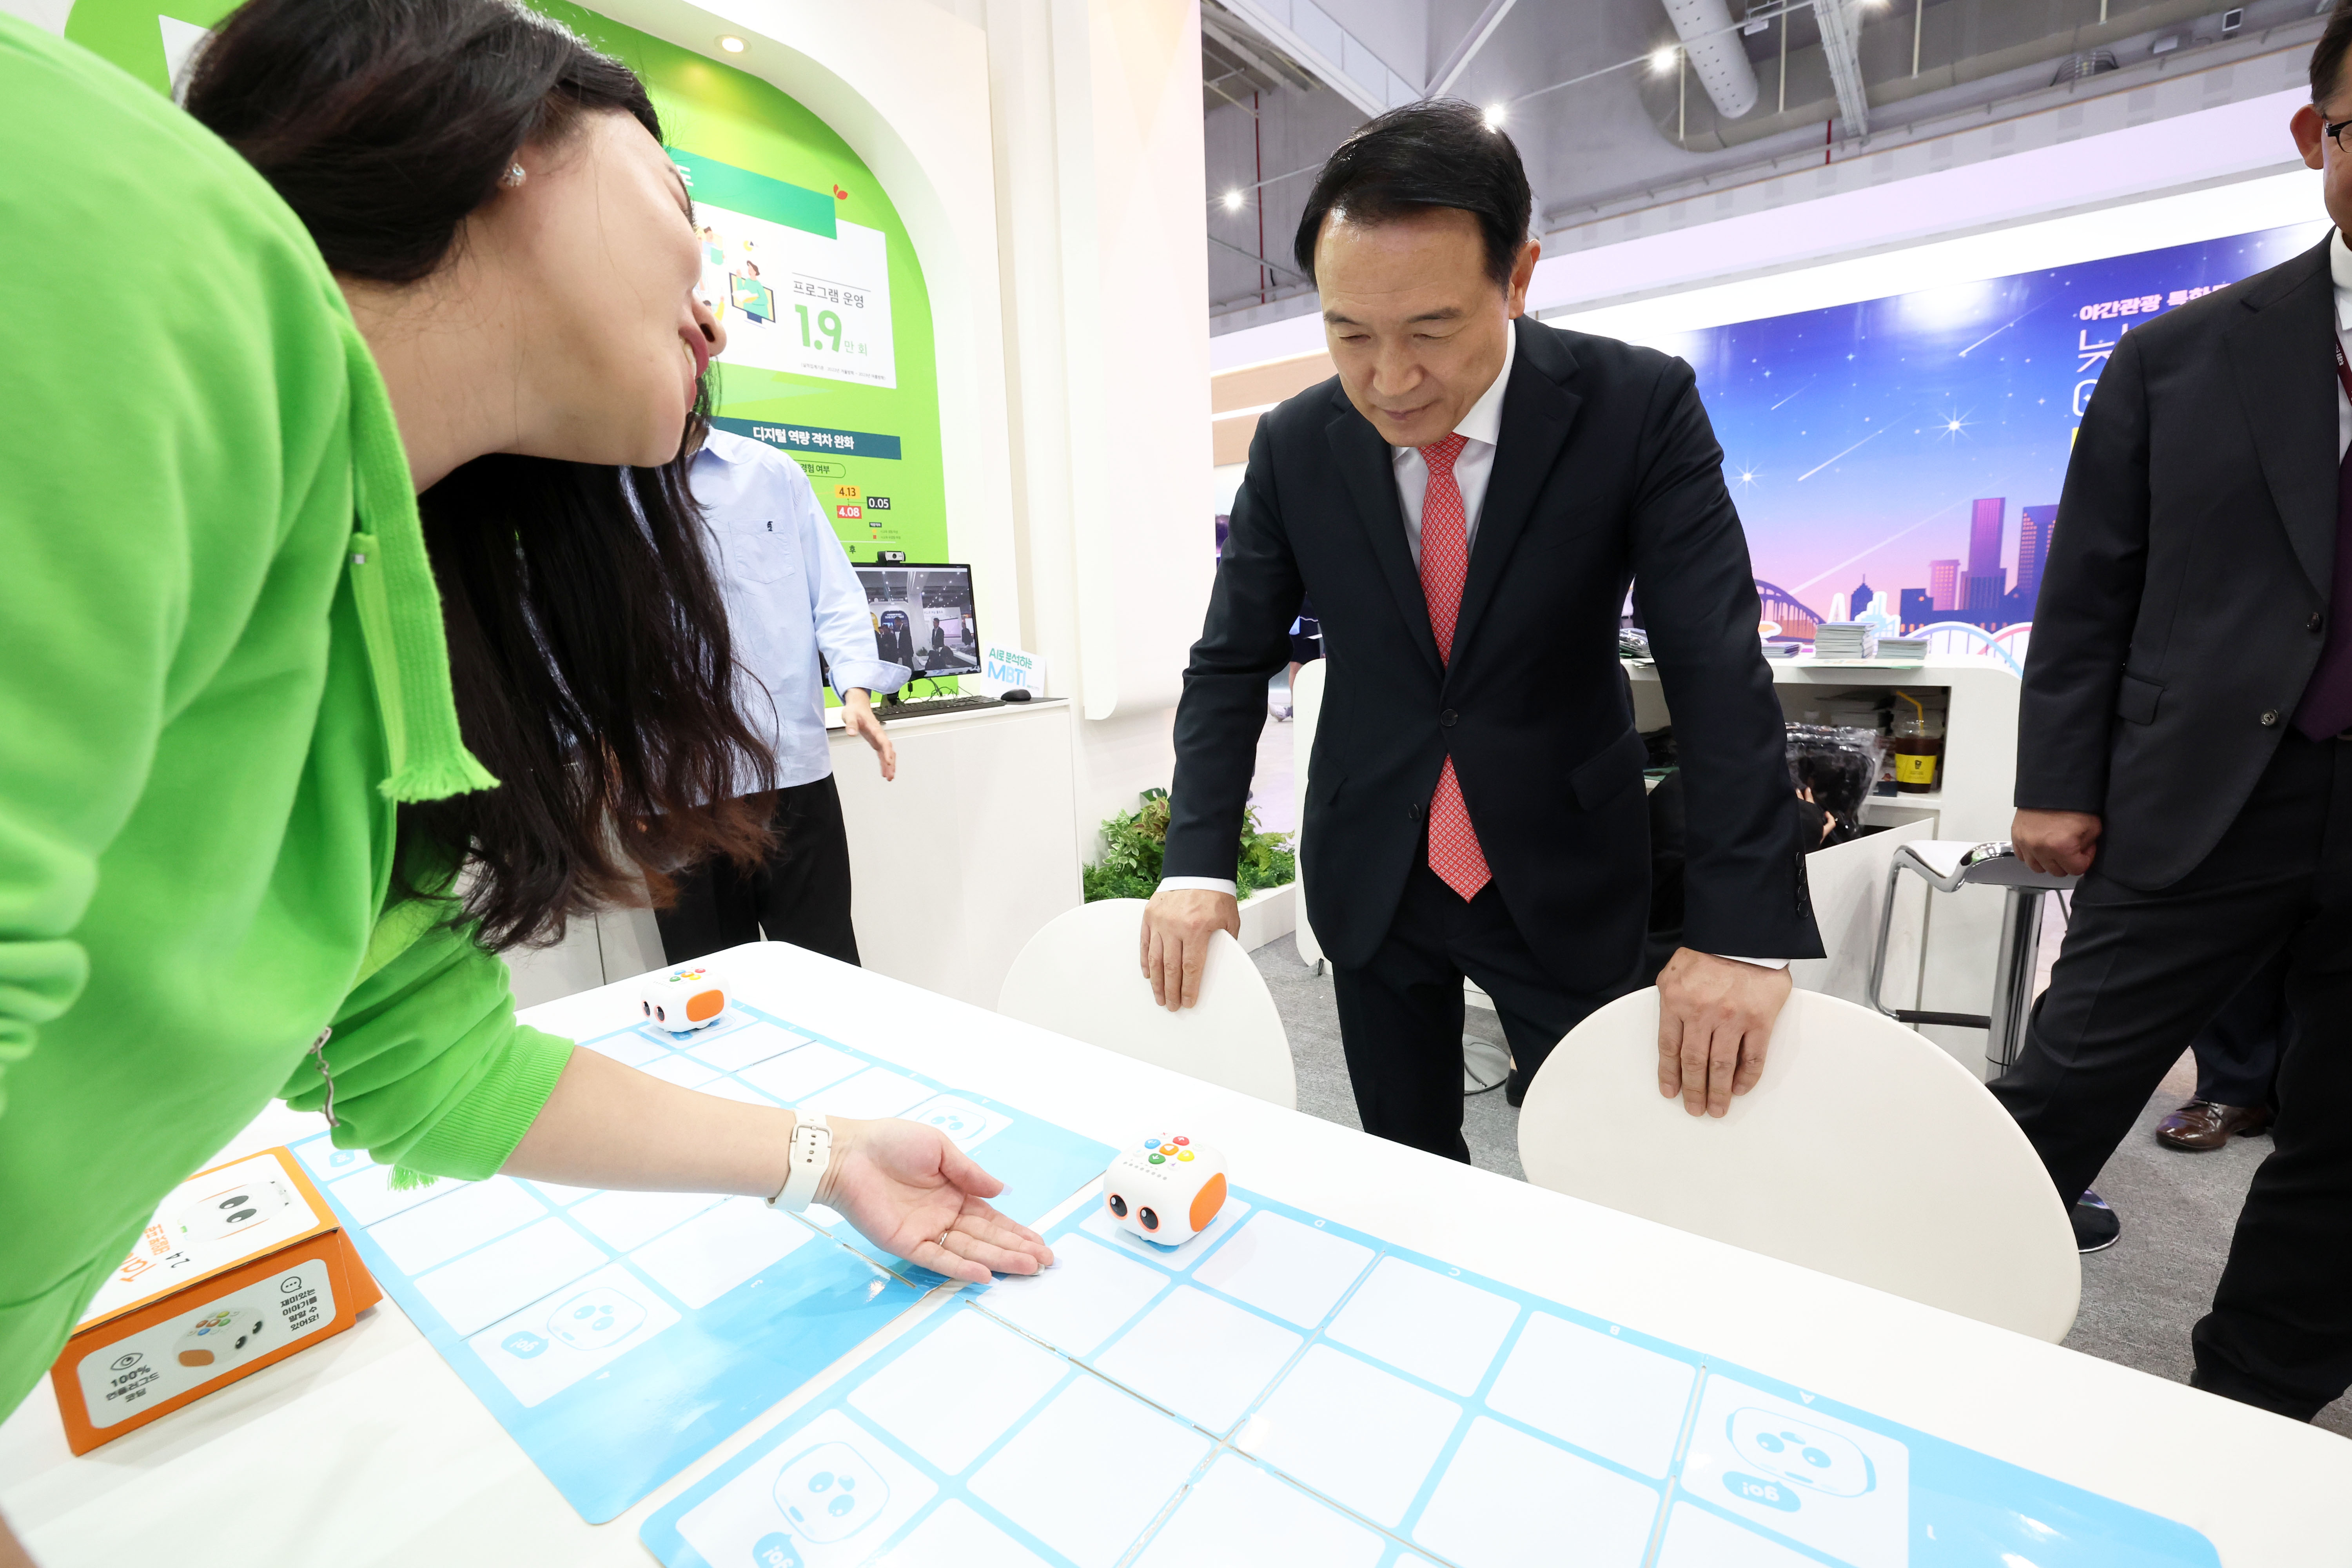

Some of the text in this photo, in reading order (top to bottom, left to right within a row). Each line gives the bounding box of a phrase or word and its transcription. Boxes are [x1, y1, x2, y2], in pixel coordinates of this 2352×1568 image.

[794, 281, 864, 309] 프로그램 운영
[2079, 294, 2162, 320] 야간관광
[795, 304, 842, 352] 1.9
[844, 340, 867, 356] 만 회
[753, 426, 855, 450] 디지털 역량 격차 완화
[800, 464, 830, 474] 경험 여부
[839, 487, 856, 497] 4.13
[839, 506, 860, 517] 4.08
[869, 498, 889, 509] 0.05
[849, 545, 856, 554] 후
[989, 648, 1033, 670] AI로 분석하는
[987, 661, 1026, 686] MBTI
[1314, 1219, 1326, 1228] D
[1448, 1267, 1461, 1276] C
[280, 1288, 315, 1308] 재미있는
[290, 1313, 319, 1332] 있어요!
[1609, 1325, 1621, 1336] B
[509, 1338, 539, 1352] go!
[111, 1364, 151, 1387] 100%
[1799, 1390, 1815, 1404] A
[1742, 1481, 1780, 1502] go!
